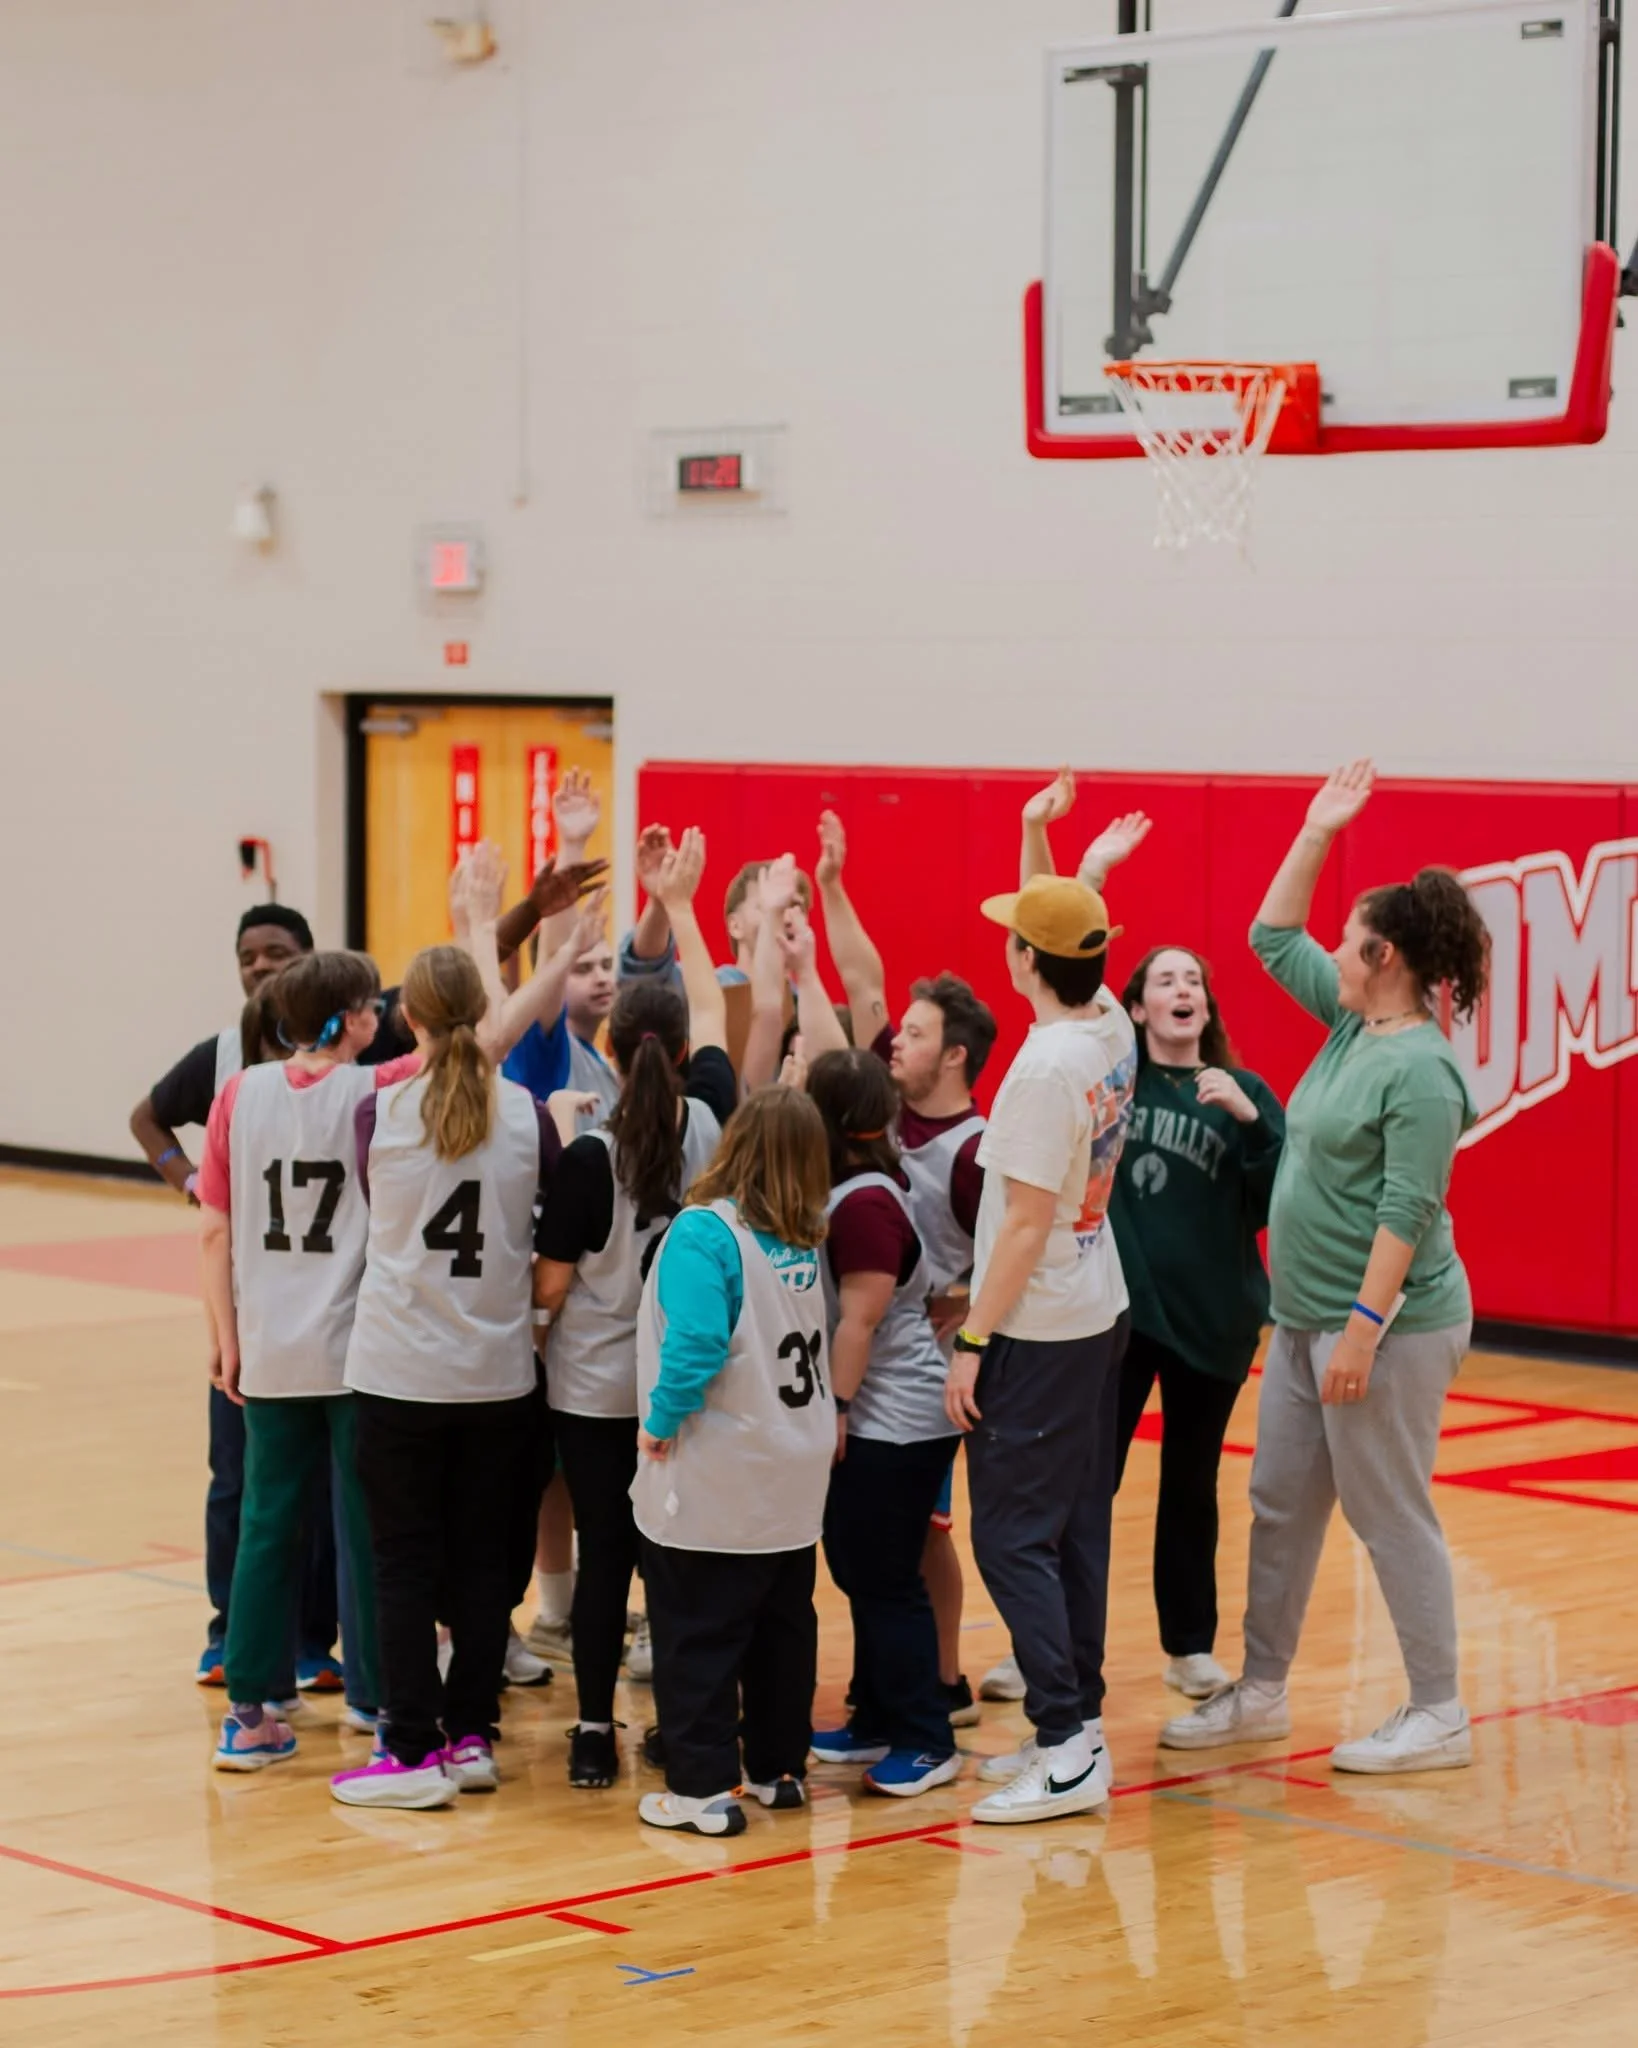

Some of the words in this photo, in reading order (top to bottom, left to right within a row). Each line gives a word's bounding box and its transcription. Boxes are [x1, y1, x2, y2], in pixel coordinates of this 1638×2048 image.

[1151, 1106, 1228, 1183] VALLEY
[263, 1158, 346, 1253] 17
[422, 1180, 485, 1278] 4
